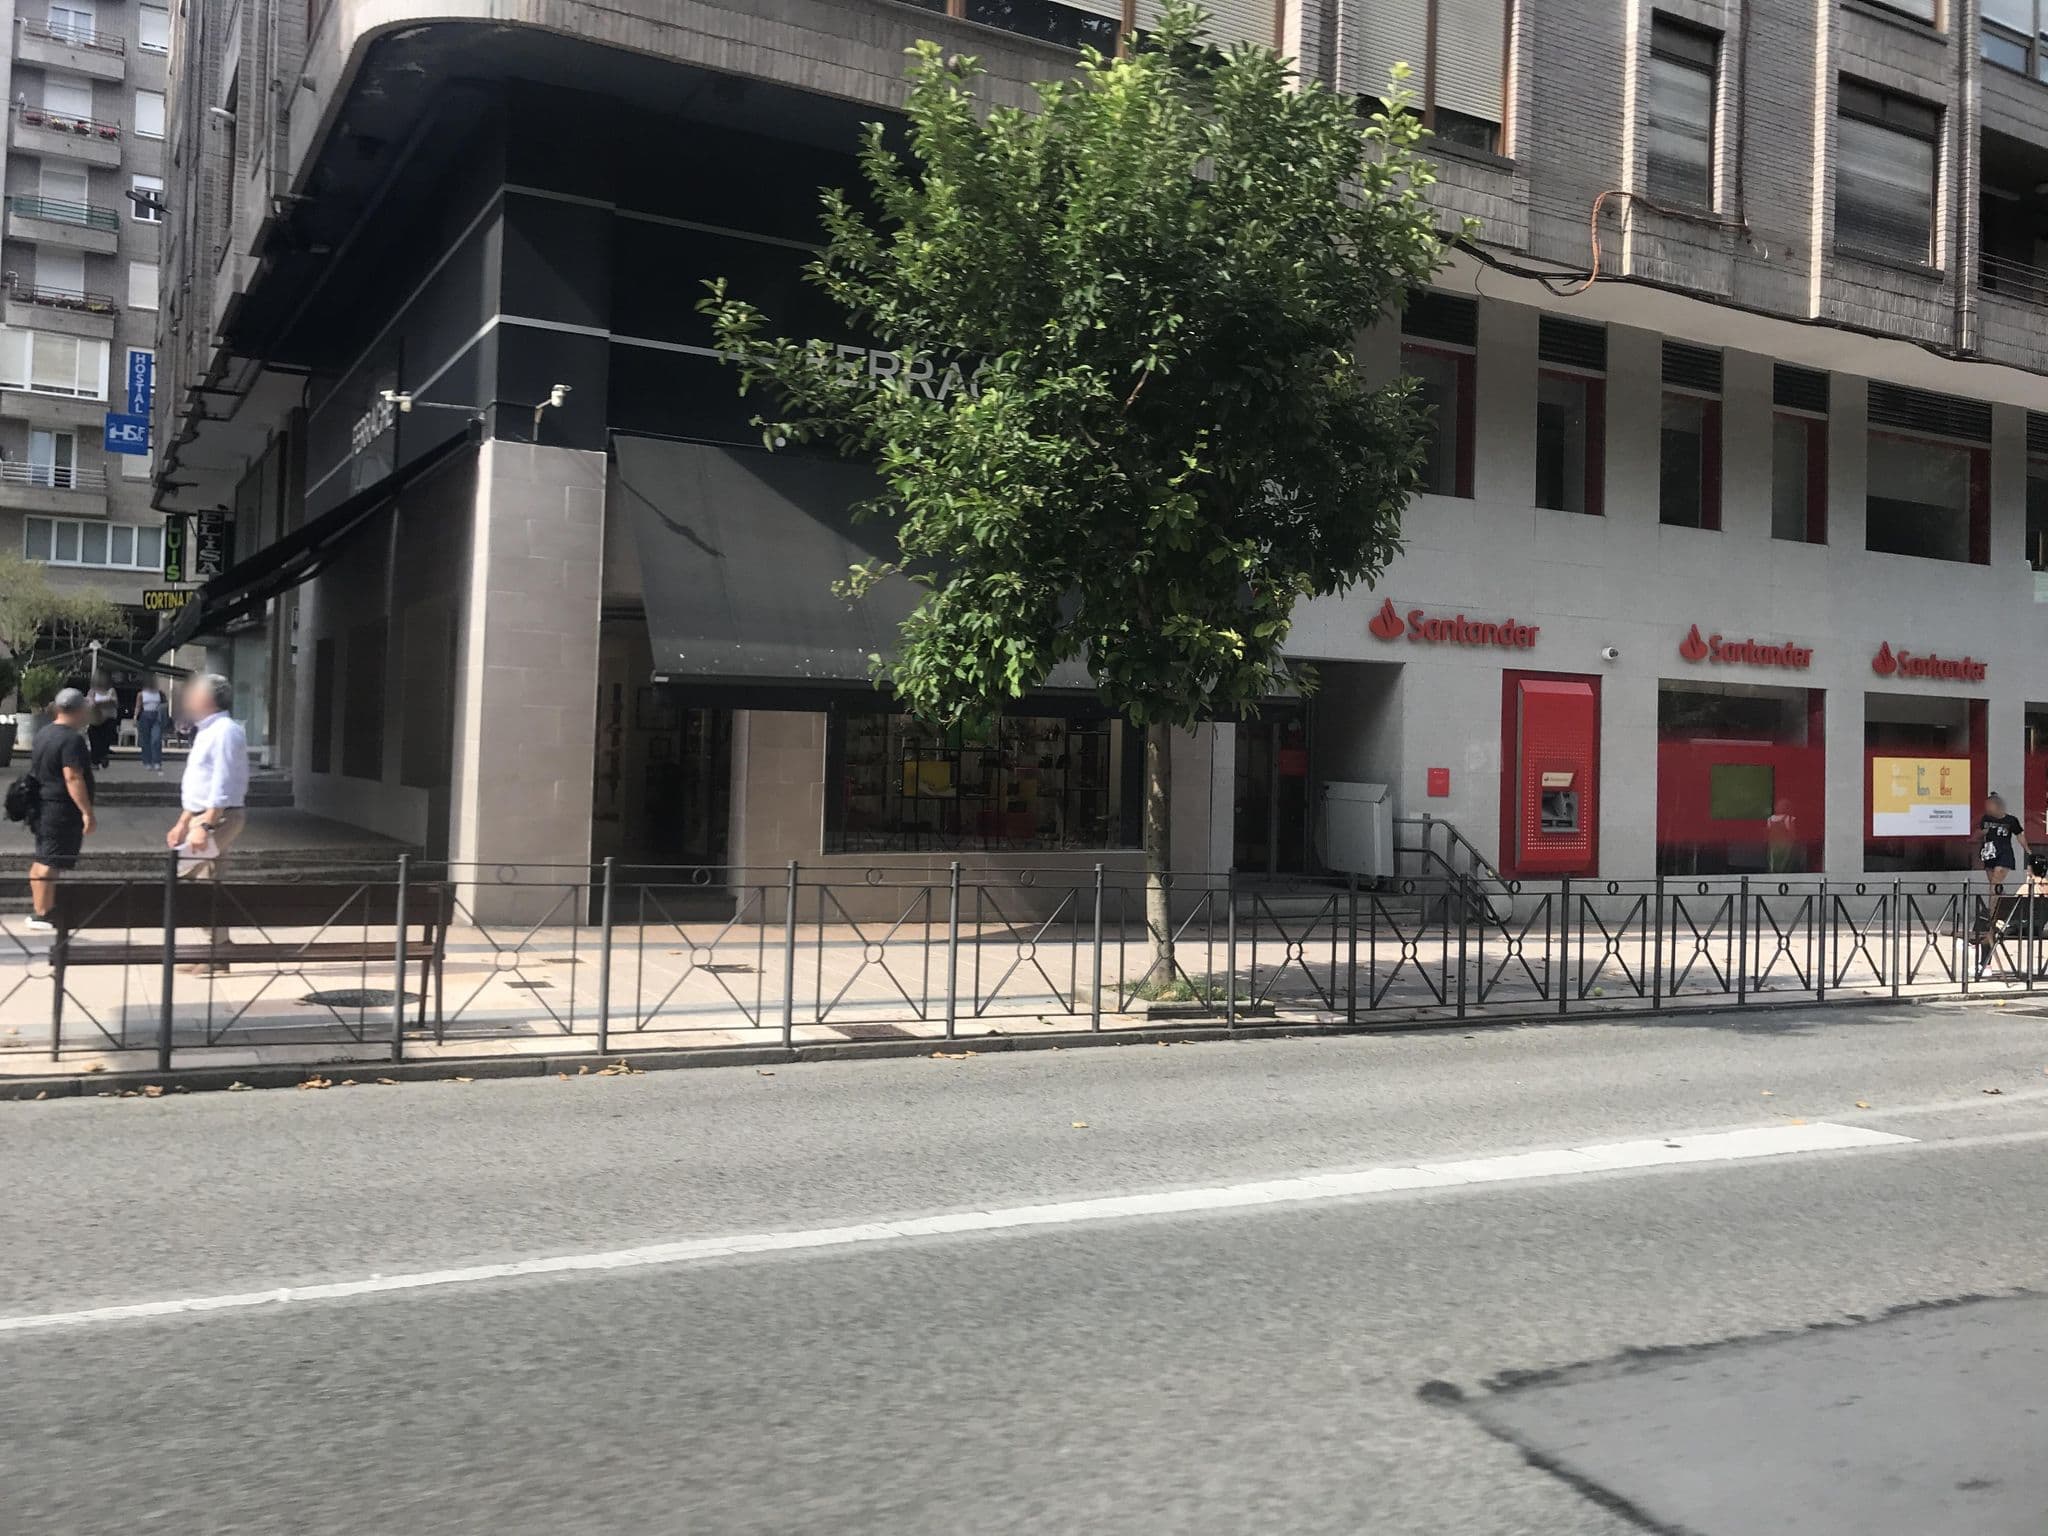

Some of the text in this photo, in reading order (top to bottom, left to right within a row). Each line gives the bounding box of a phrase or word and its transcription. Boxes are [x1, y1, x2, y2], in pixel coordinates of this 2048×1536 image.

[134, 354, 146, 414] HOSTAL
[166, 519, 182, 580] LUIS
[1407, 609, 1540, 647] Santander
[1709, 635, 1814, 667] Santander
[1897, 650, 1988, 680] Santander
